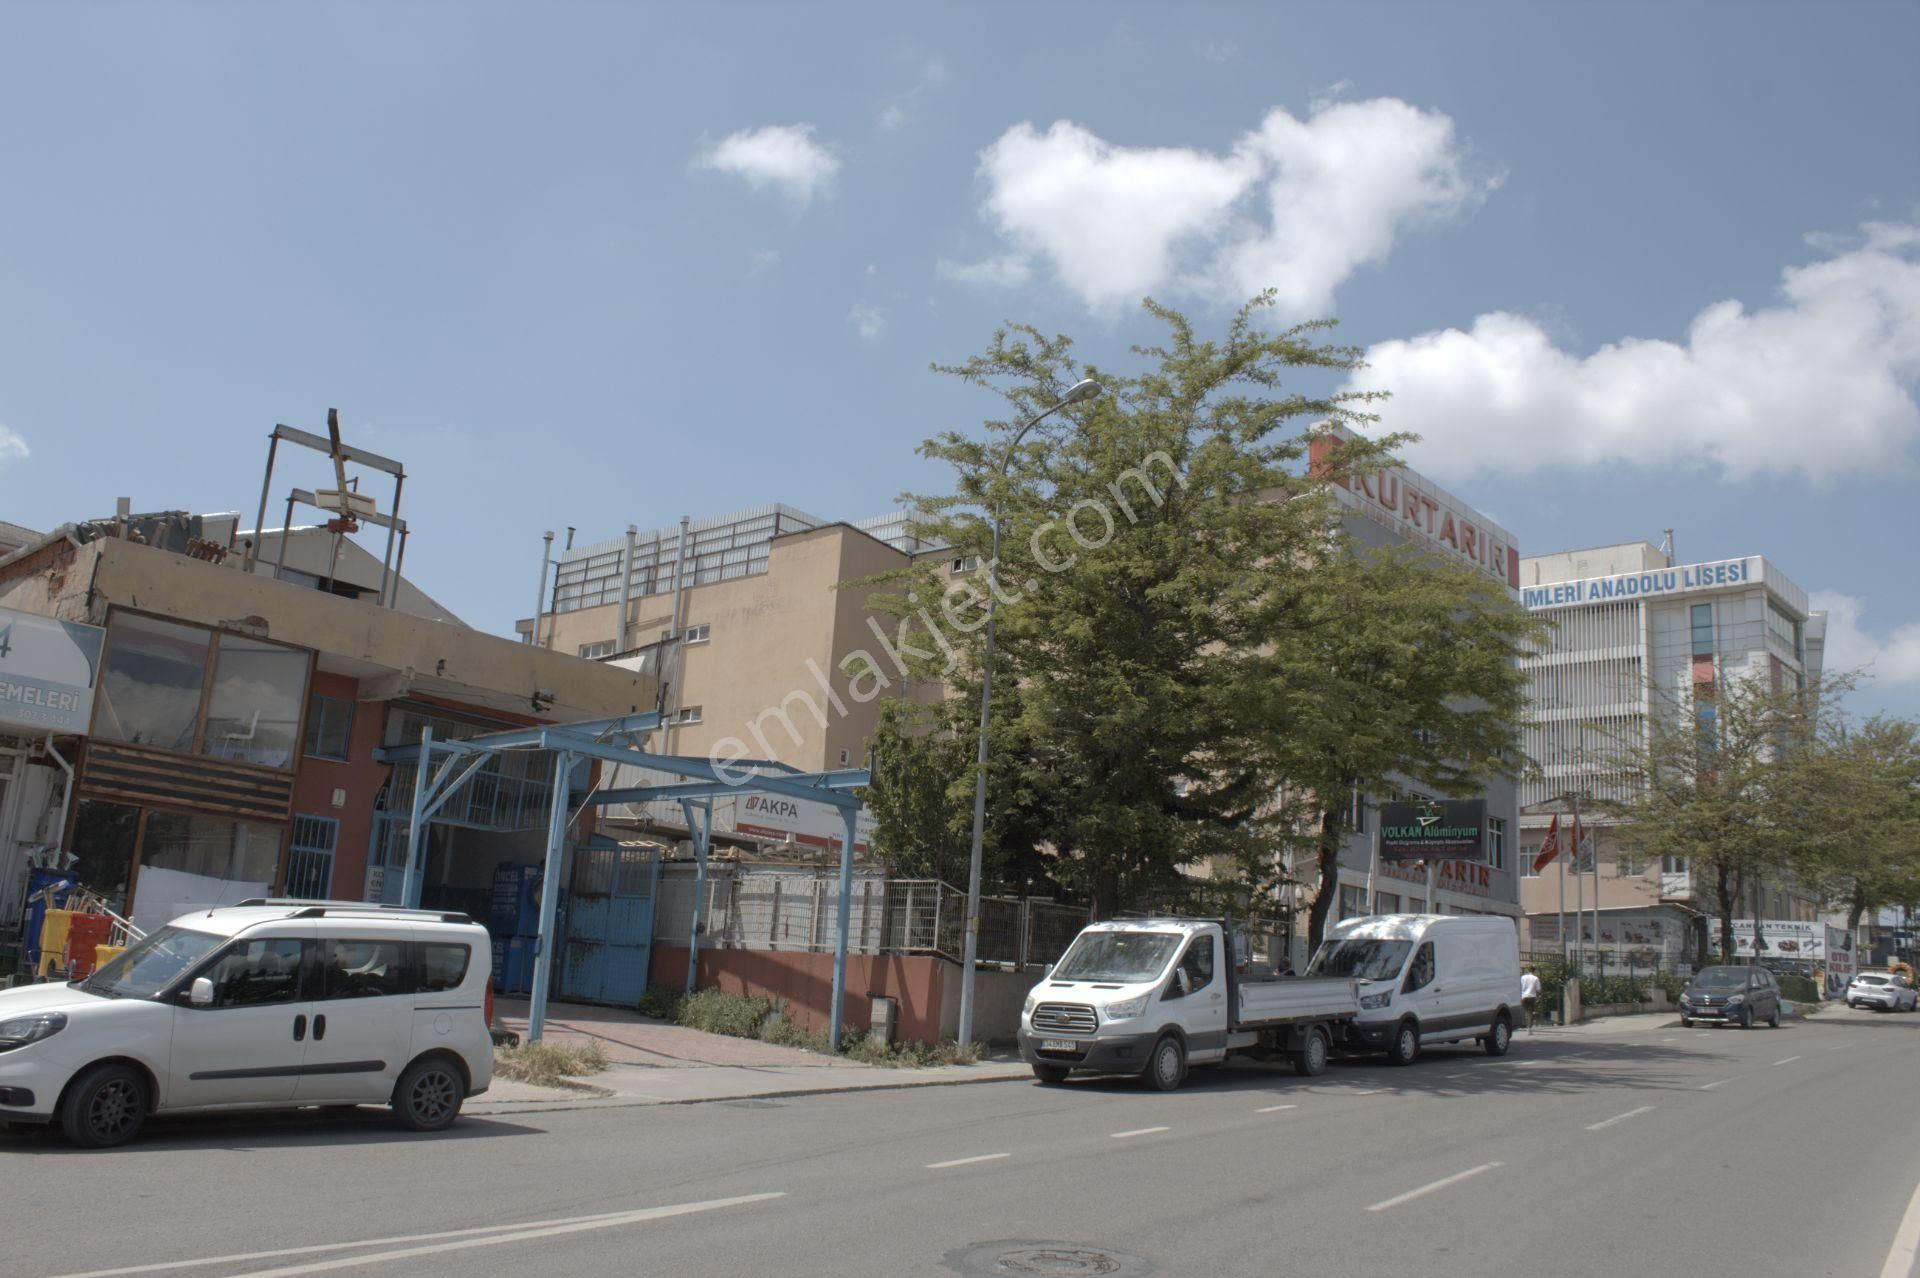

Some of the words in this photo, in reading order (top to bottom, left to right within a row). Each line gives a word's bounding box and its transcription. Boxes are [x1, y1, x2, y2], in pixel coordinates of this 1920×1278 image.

[1589, 571, 1676, 600] ANADOLU
[1685, 559, 1748, 588] LİSESİ
[759, 798, 798, 818] AKPA
[1381, 826, 1421, 838] VOLKAN
[1424, 825, 1478, 839] Alüminyum
[1831, 951, 1849, 962] OTO
